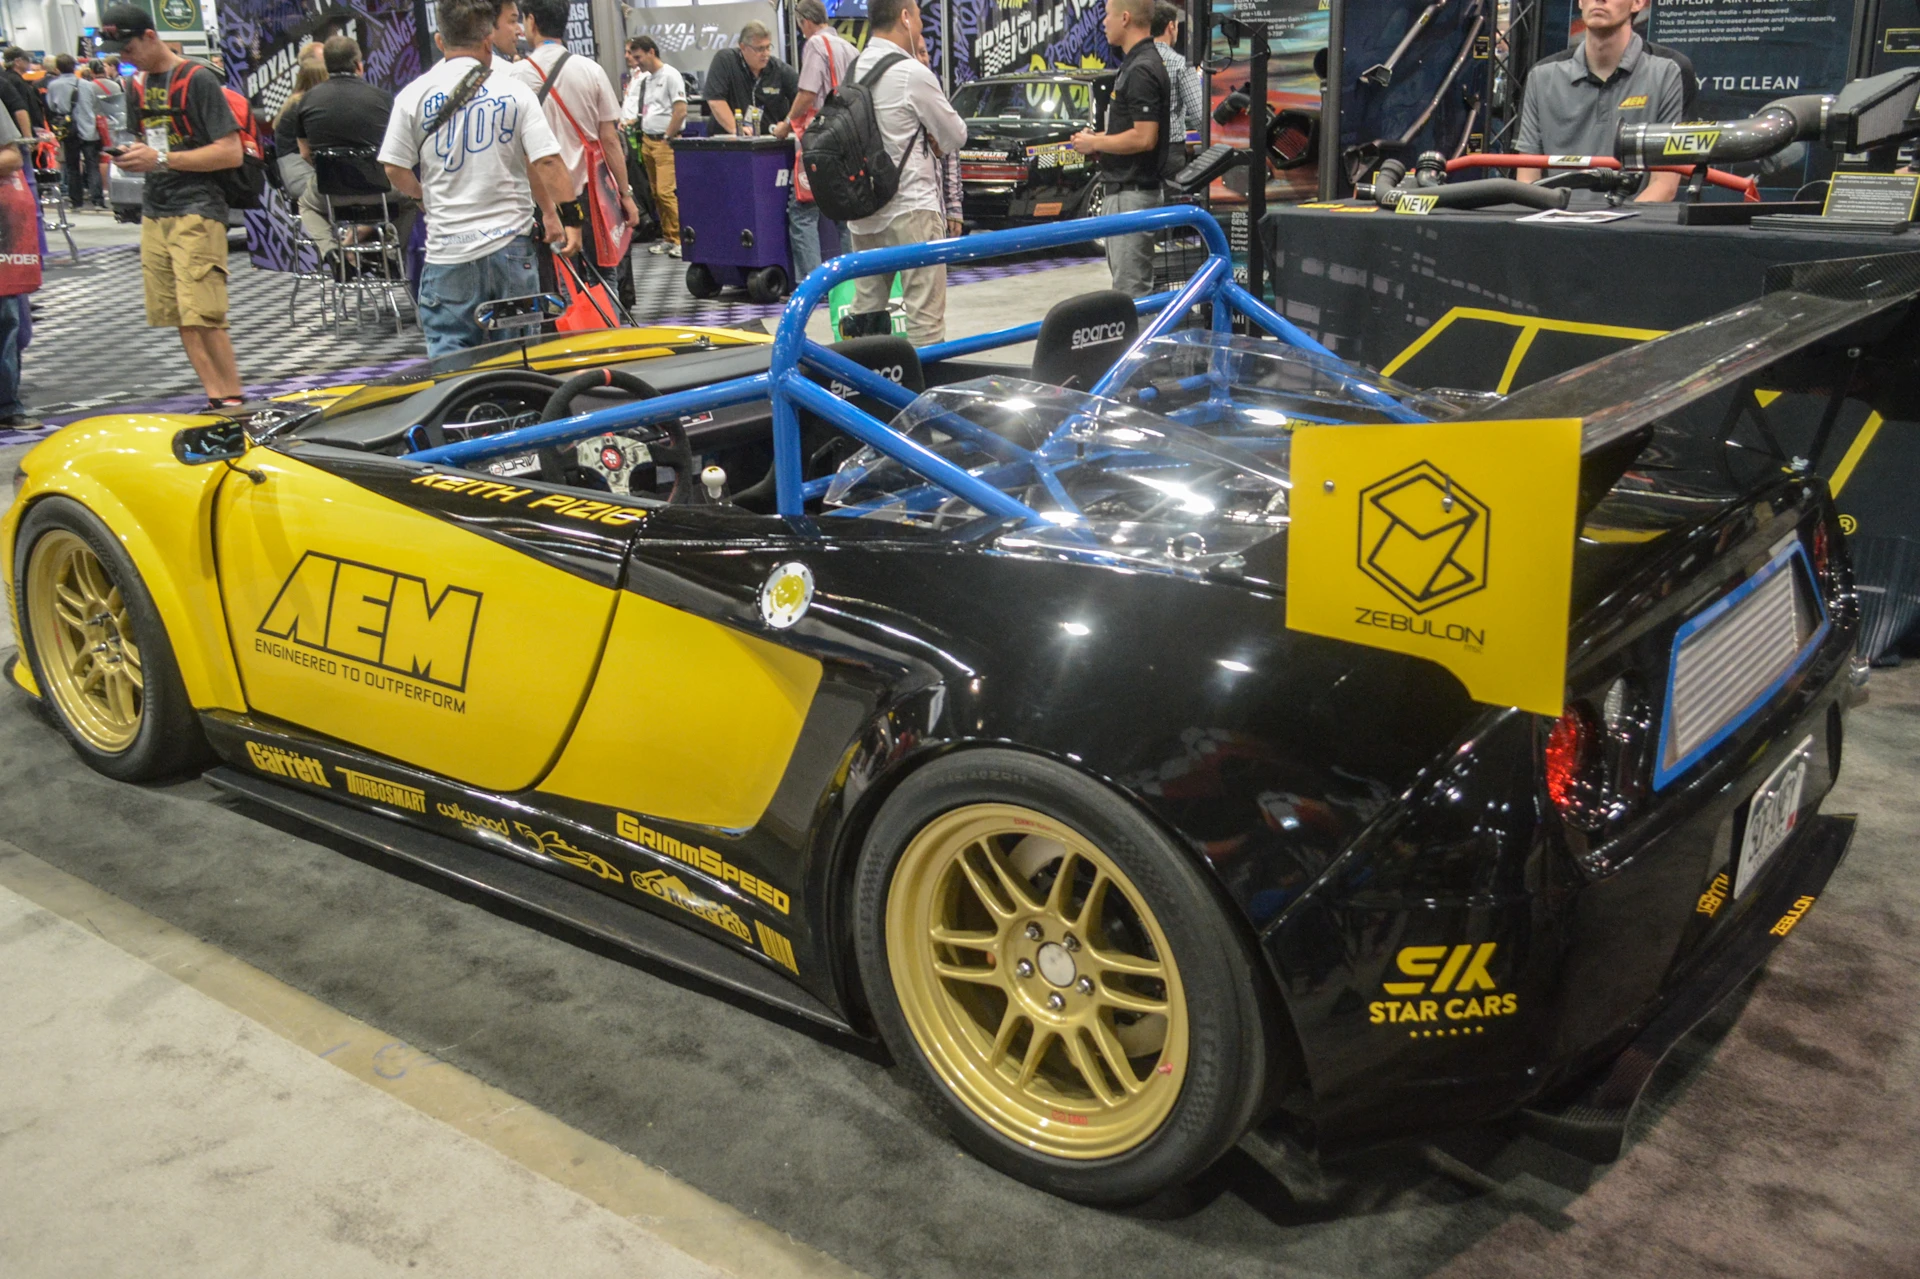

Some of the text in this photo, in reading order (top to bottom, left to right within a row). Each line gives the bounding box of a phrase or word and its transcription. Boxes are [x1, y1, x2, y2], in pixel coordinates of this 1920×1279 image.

[1761, 7, 1790, 15] required
[1011, 3, 1064, 62] PURPLE
[1713, 76, 1735, 90] TO
[1740, 75, 1800, 90] CLEAN
[1667, 132, 1717, 152] NEW
[1398, 197, 1436, 213] NEW
[1071, 320, 1126, 349] sparco
[411, 473, 534, 503] KEITH
[256, 549, 485, 693] AEM
[1355, 606, 1485, 646] ZEBULON
[255, 638, 467, 715] ENGINEERED TO OUTPERFORM
[245, 740, 332, 788] Garrett
[334, 766, 427, 814] TURBOSMART
[436, 802, 511, 836] wilwood
[616, 811, 790, 915] GRIMMSPEED
[1769, 894, 1815, 937] ZEBULON
[1368, 992, 1518, 1024] STAR CARS
